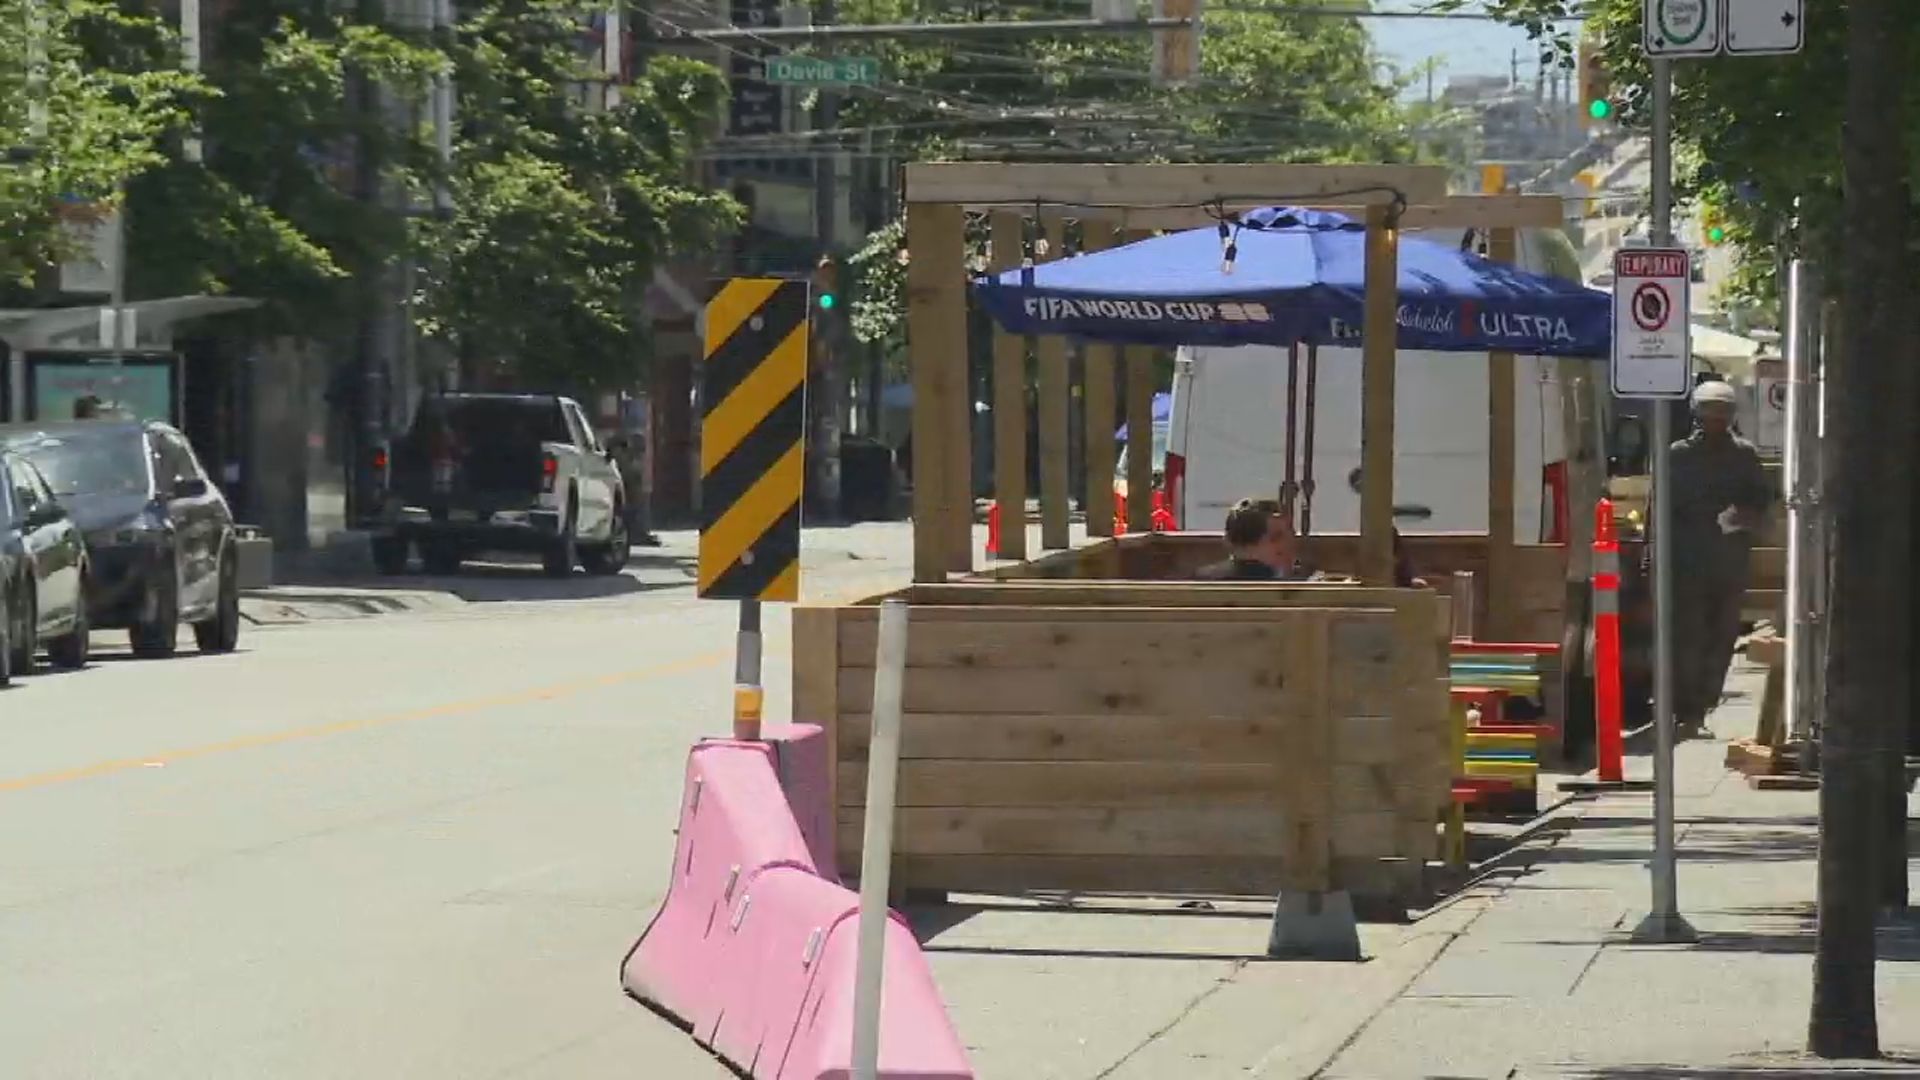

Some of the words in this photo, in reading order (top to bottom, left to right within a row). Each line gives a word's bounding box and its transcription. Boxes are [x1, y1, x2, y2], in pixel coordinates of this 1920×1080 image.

[778, 63, 834, 80] Davie
[845, 63, 867, 80] St
[1024, 297, 1079, 319] FIFA
[1080, 301, 1162, 320] WORLD
[1165, 302, 1215, 320] CUP
[1480, 312, 1576, 341] ULTRA
